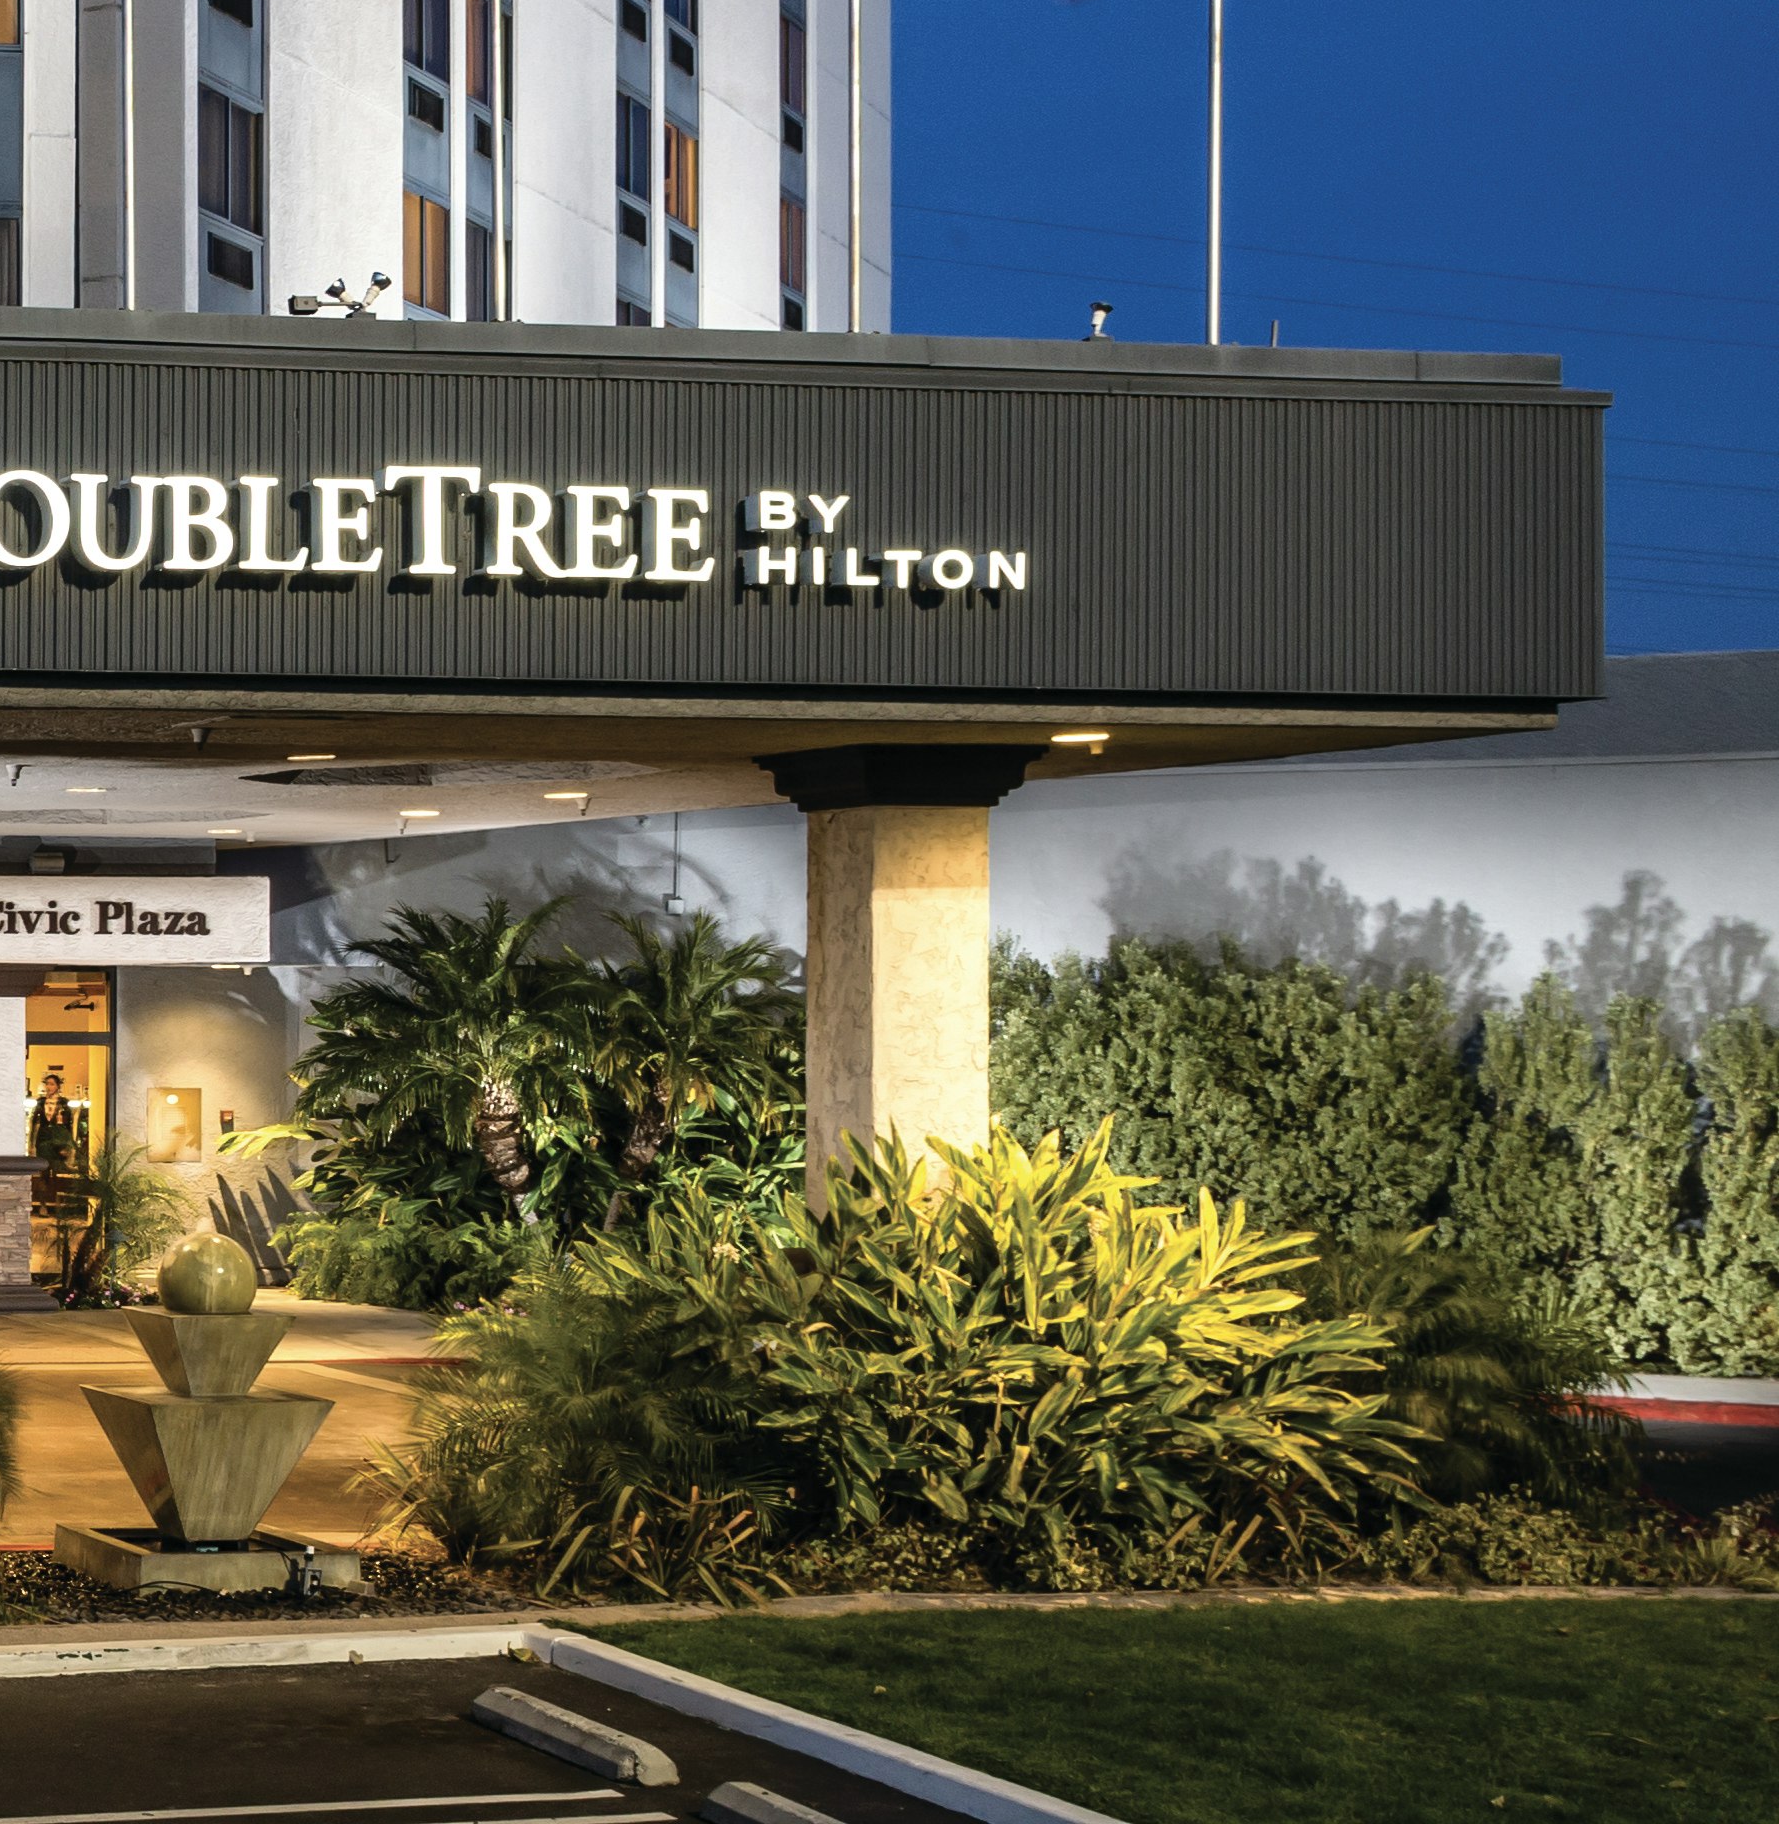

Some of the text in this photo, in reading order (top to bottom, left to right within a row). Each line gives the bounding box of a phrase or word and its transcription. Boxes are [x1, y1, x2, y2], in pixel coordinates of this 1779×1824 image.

[758, 490, 850, 534] BY
[757, 545, 1027, 591] HILTON
[94, 900, 211, 936] Plaza
